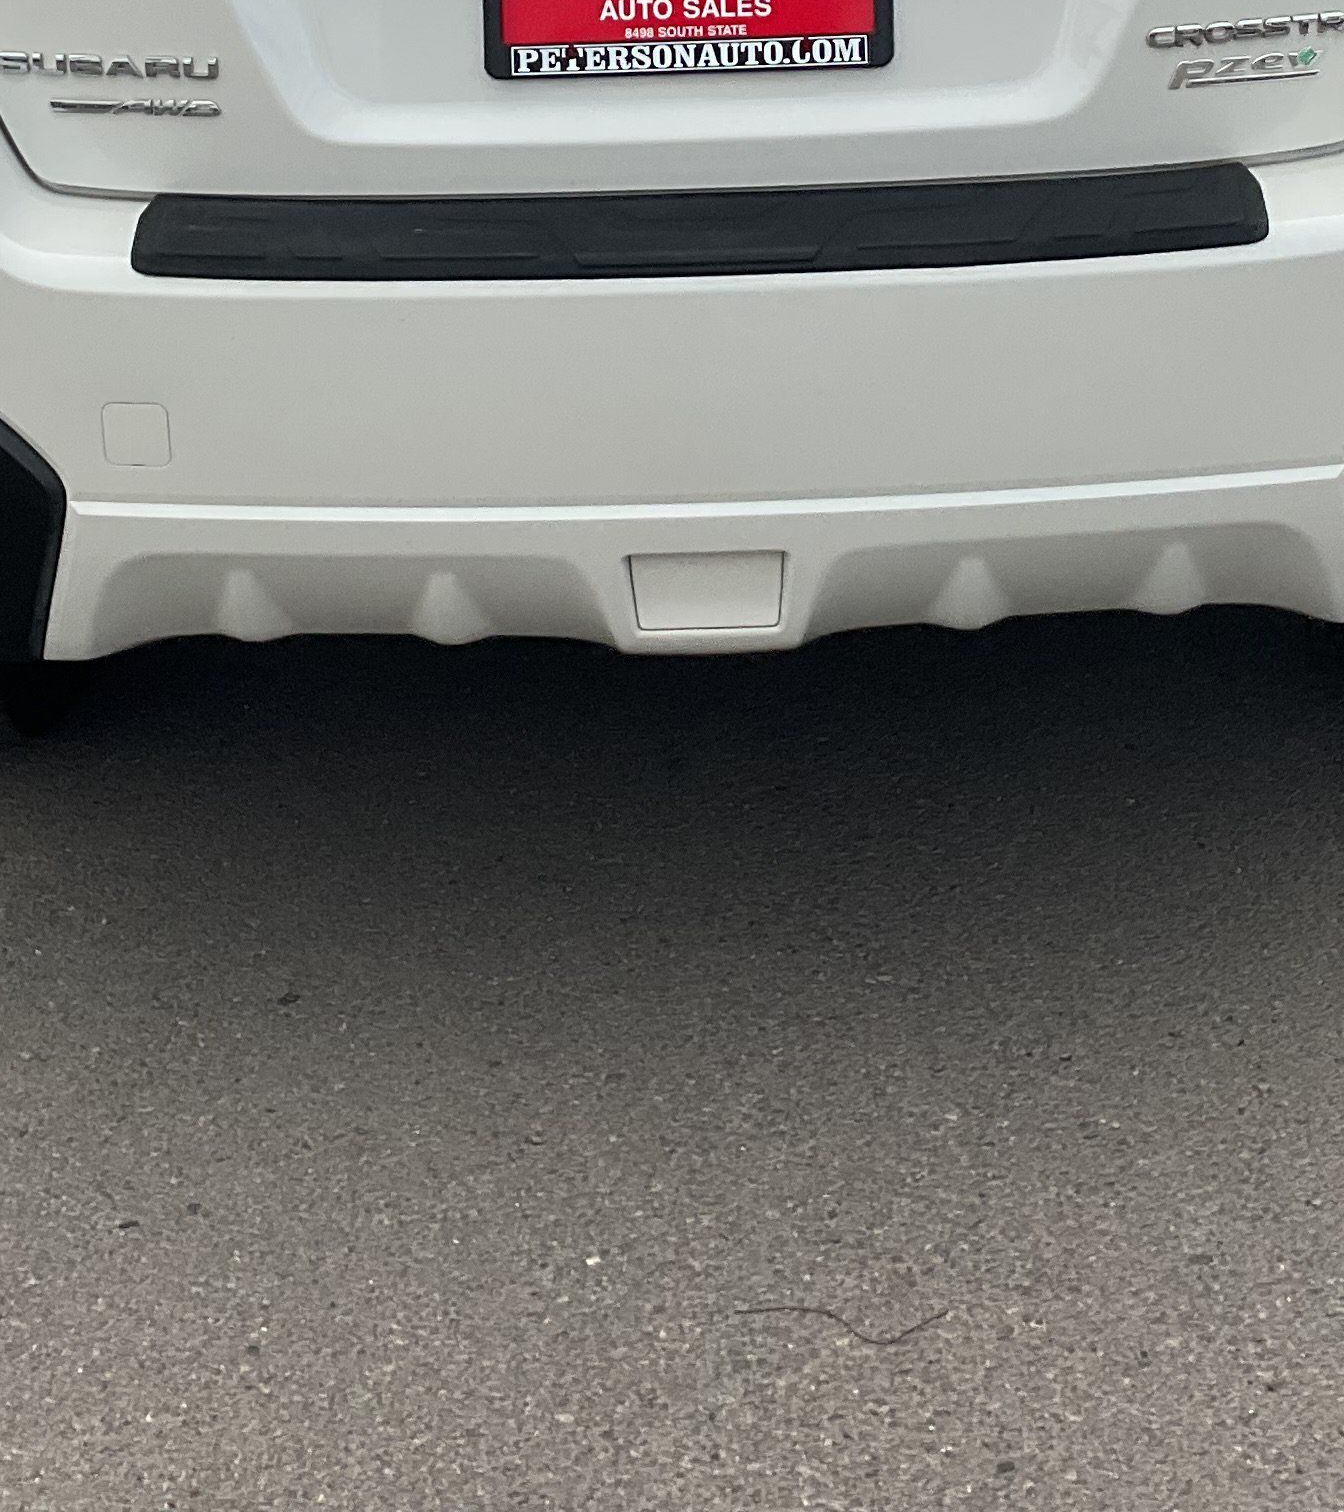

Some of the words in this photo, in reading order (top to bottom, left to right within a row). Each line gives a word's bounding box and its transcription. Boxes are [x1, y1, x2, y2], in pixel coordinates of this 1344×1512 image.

[625, 28, 654, 39] 8498
[658, 26, 703, 38] SOUTH
[707, 24, 747, 36] STATE
